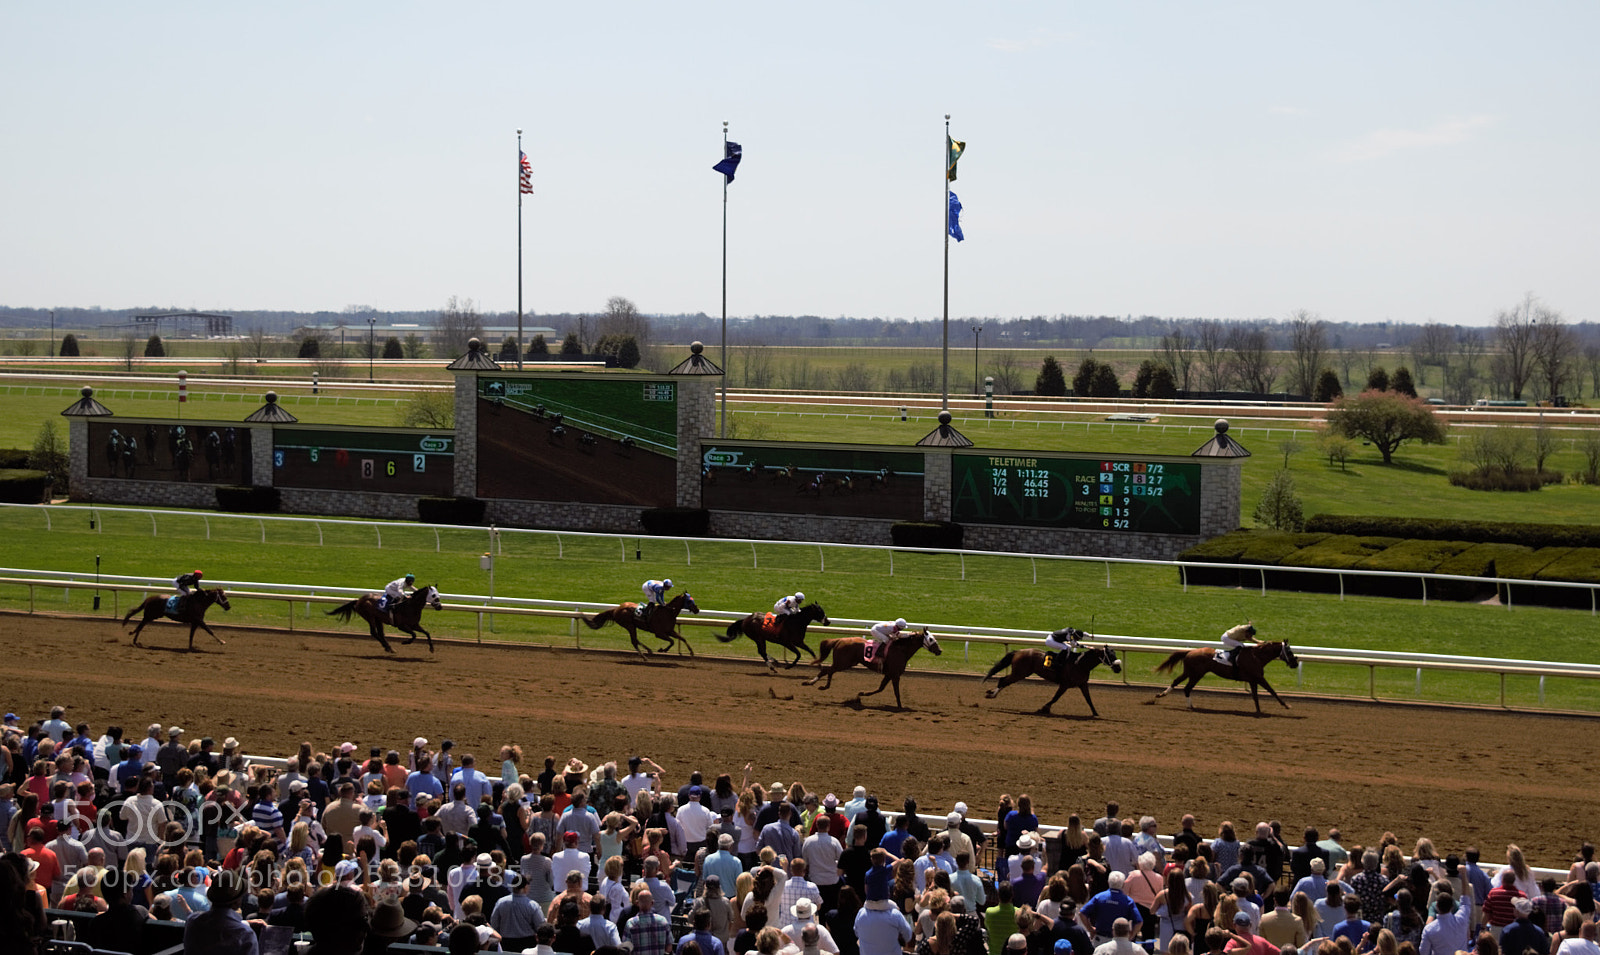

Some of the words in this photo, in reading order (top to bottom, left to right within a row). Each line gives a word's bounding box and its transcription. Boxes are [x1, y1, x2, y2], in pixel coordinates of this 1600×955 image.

[275, 453, 282, 467] 3
[311, 450, 318, 462] 5
[416, 457, 423, 470] 2
[989, 457, 1037, 468] TELETIMER
[1105, 463, 1108, 471] 1
[1113, 463, 1130, 472] SCR
[364, 462, 372, 477] 8
[387, 461, 395, 476] 6
[992, 468, 1007, 477] 3/4
[1017, 469, 1048, 478] 1:11.22
[1148, 464, 1163, 474] 7/2
[993, 478, 1007, 487] 1/2
[1024, 480, 1048, 488] 46.45
[1124, 475, 1129, 483] 7
[993, 487, 1007, 496] 1/4
[1024, 489, 1048, 498] 23.12
[1082, 485, 1089, 495] 3
[1124, 486, 1129, 494] 5
[1136, 486, 1142, 494] 9
[1148, 487, 1163, 496] 5/2
[1114, 520, 1129, 528] 5/2
[378, 597, 388, 608] 3
[635, 605, 642, 616] 5
[865, 647, 873, 658] 8
[1043, 655, 1053, 667] 6
